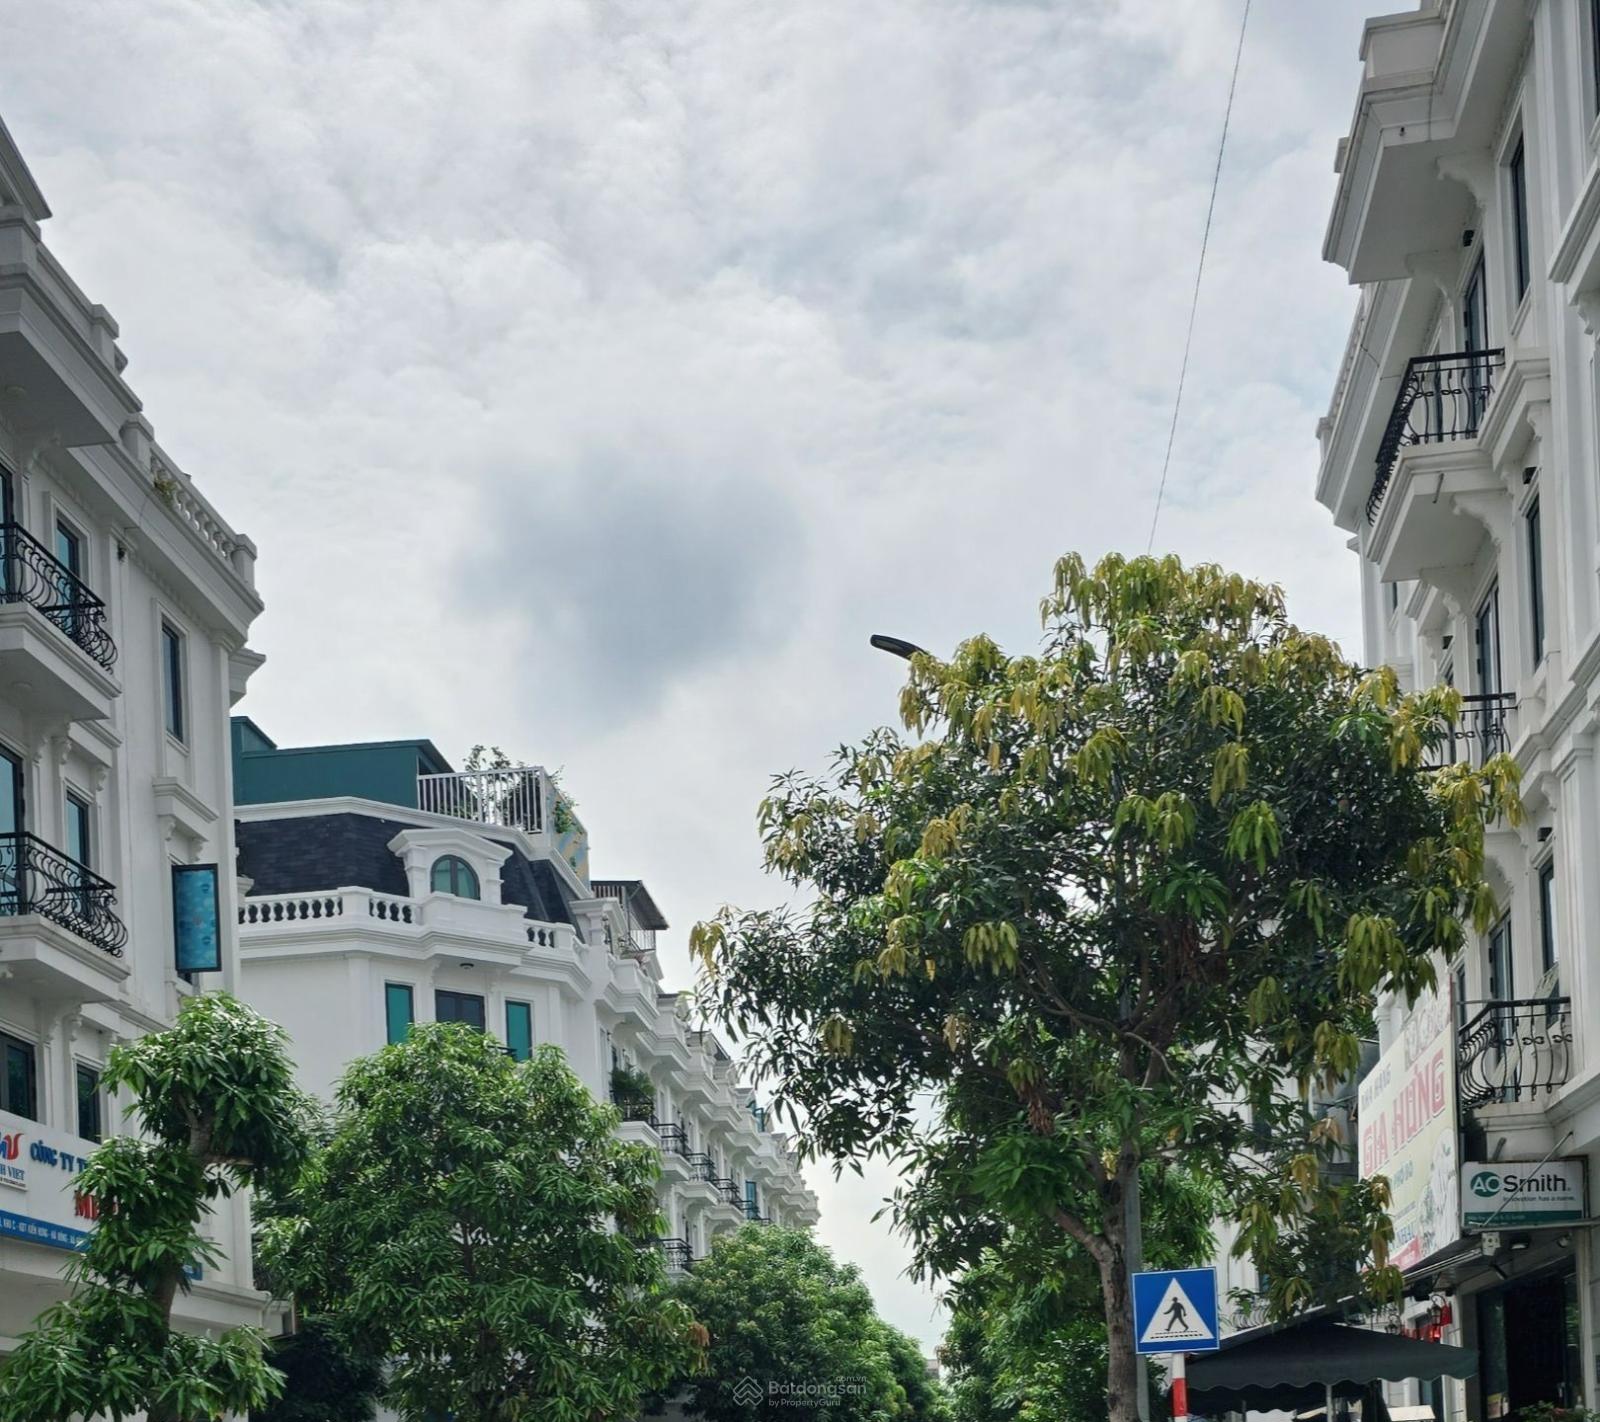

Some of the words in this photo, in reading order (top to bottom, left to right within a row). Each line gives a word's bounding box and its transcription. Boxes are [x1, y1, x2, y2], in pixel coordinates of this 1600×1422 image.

[1363, 1111, 1388, 1178] GIA
[60, 1151, 75, 1173] TY
[1472, 1175, 1500, 1193] AO
[1503, 1174, 1567, 1192] Smith
